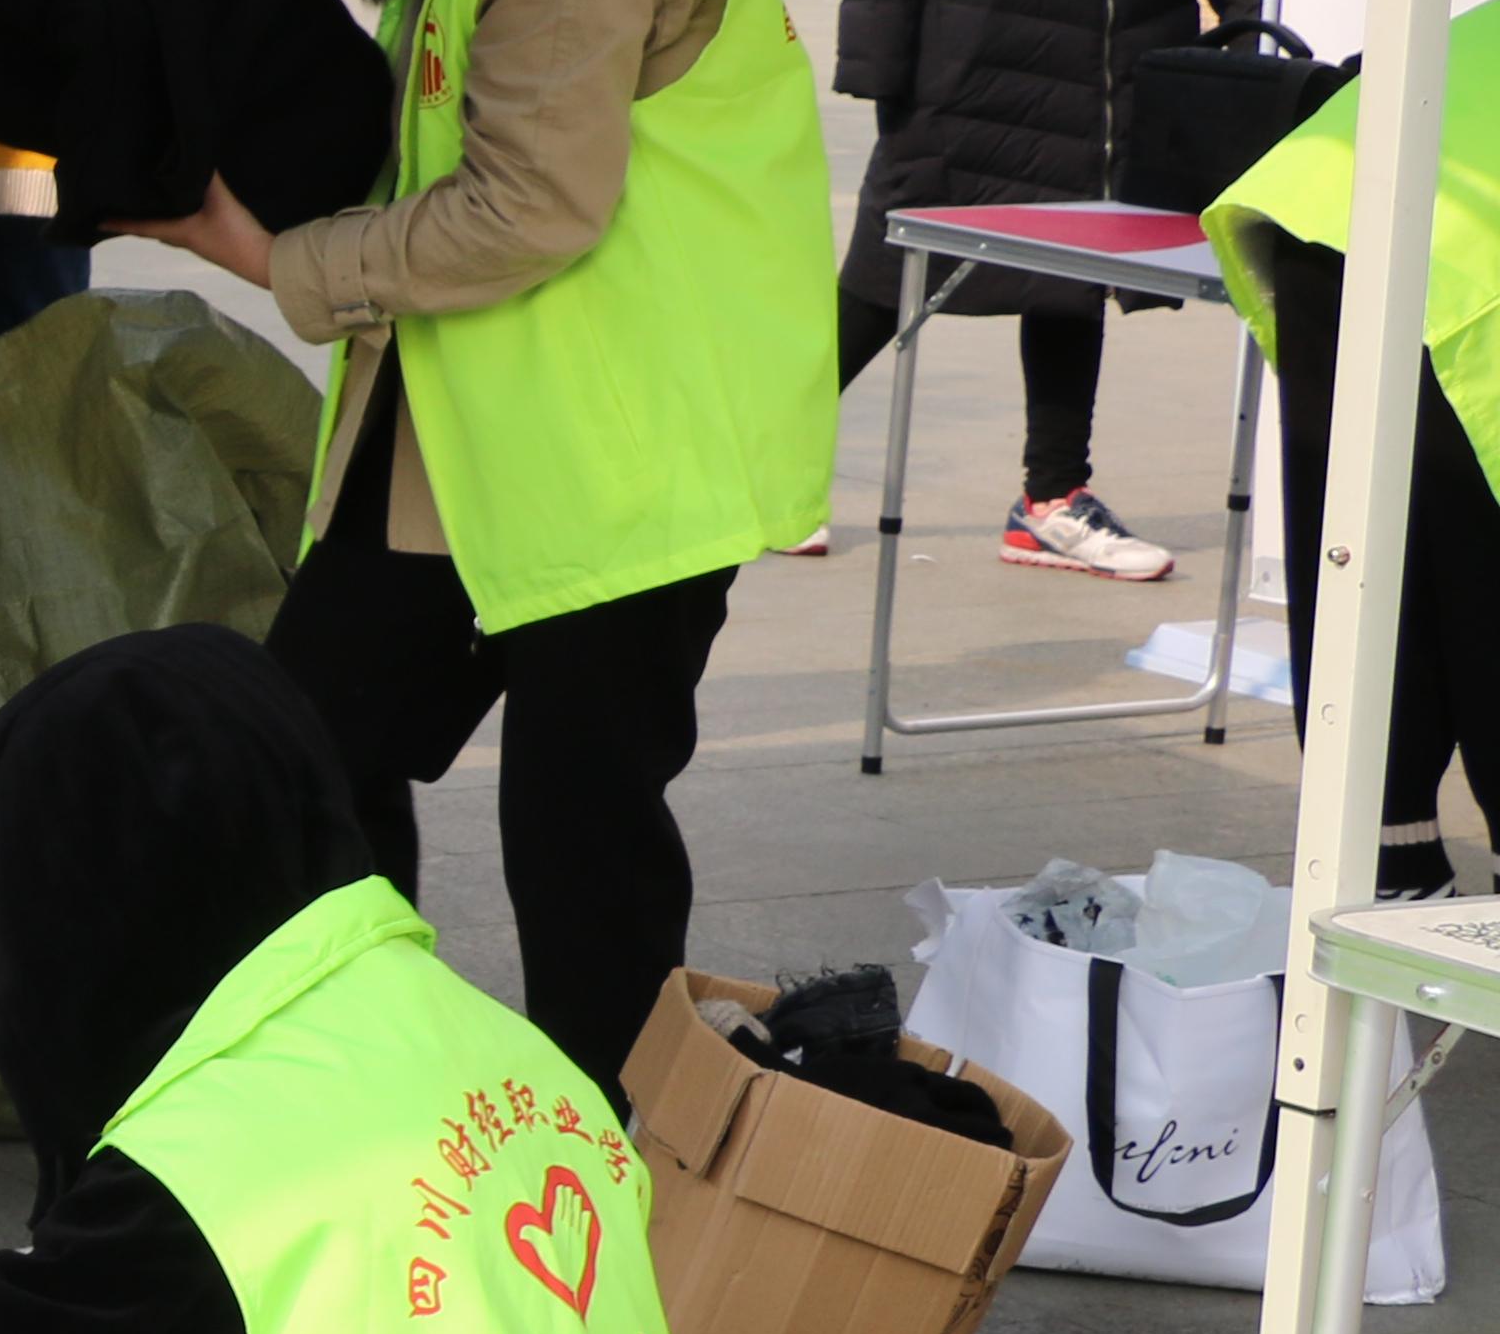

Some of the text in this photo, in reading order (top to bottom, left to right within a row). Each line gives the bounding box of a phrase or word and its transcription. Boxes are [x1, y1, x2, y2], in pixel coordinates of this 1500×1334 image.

[408, 1078, 643, 1319] 四川财经职业学
